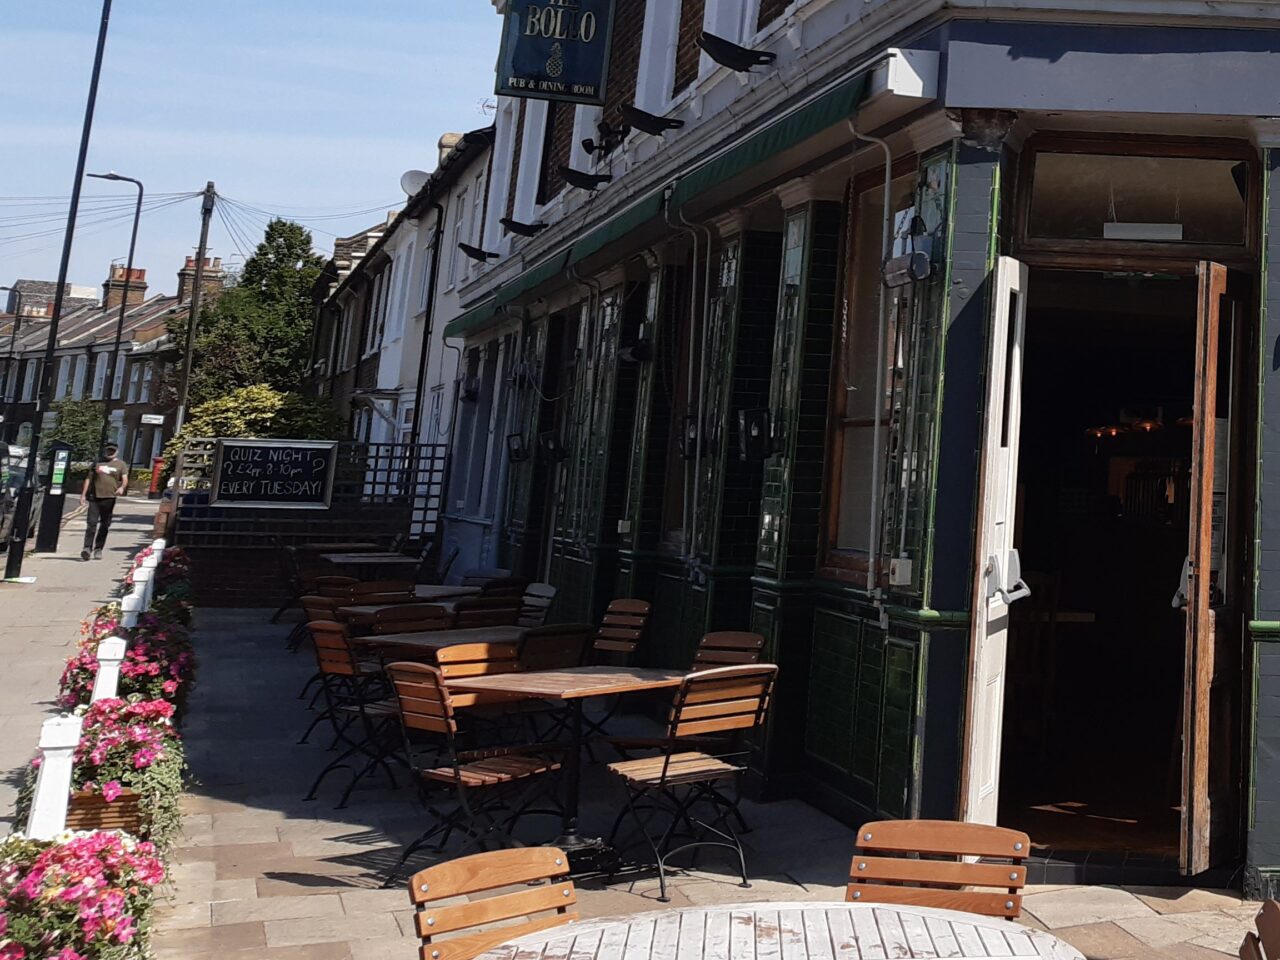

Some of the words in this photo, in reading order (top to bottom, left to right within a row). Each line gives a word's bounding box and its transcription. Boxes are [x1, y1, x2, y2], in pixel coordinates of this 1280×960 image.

[524, 5, 596, 42] BOLLO
[508, 77, 526, 88] PUB
[528, 79, 535, 89] &
[230, 447, 262, 461] QUIZ
[268, 449, 317, 463] NIGHT
[220, 480, 256, 495] EVERY
[260, 480, 322, 496] TUESDAY!
